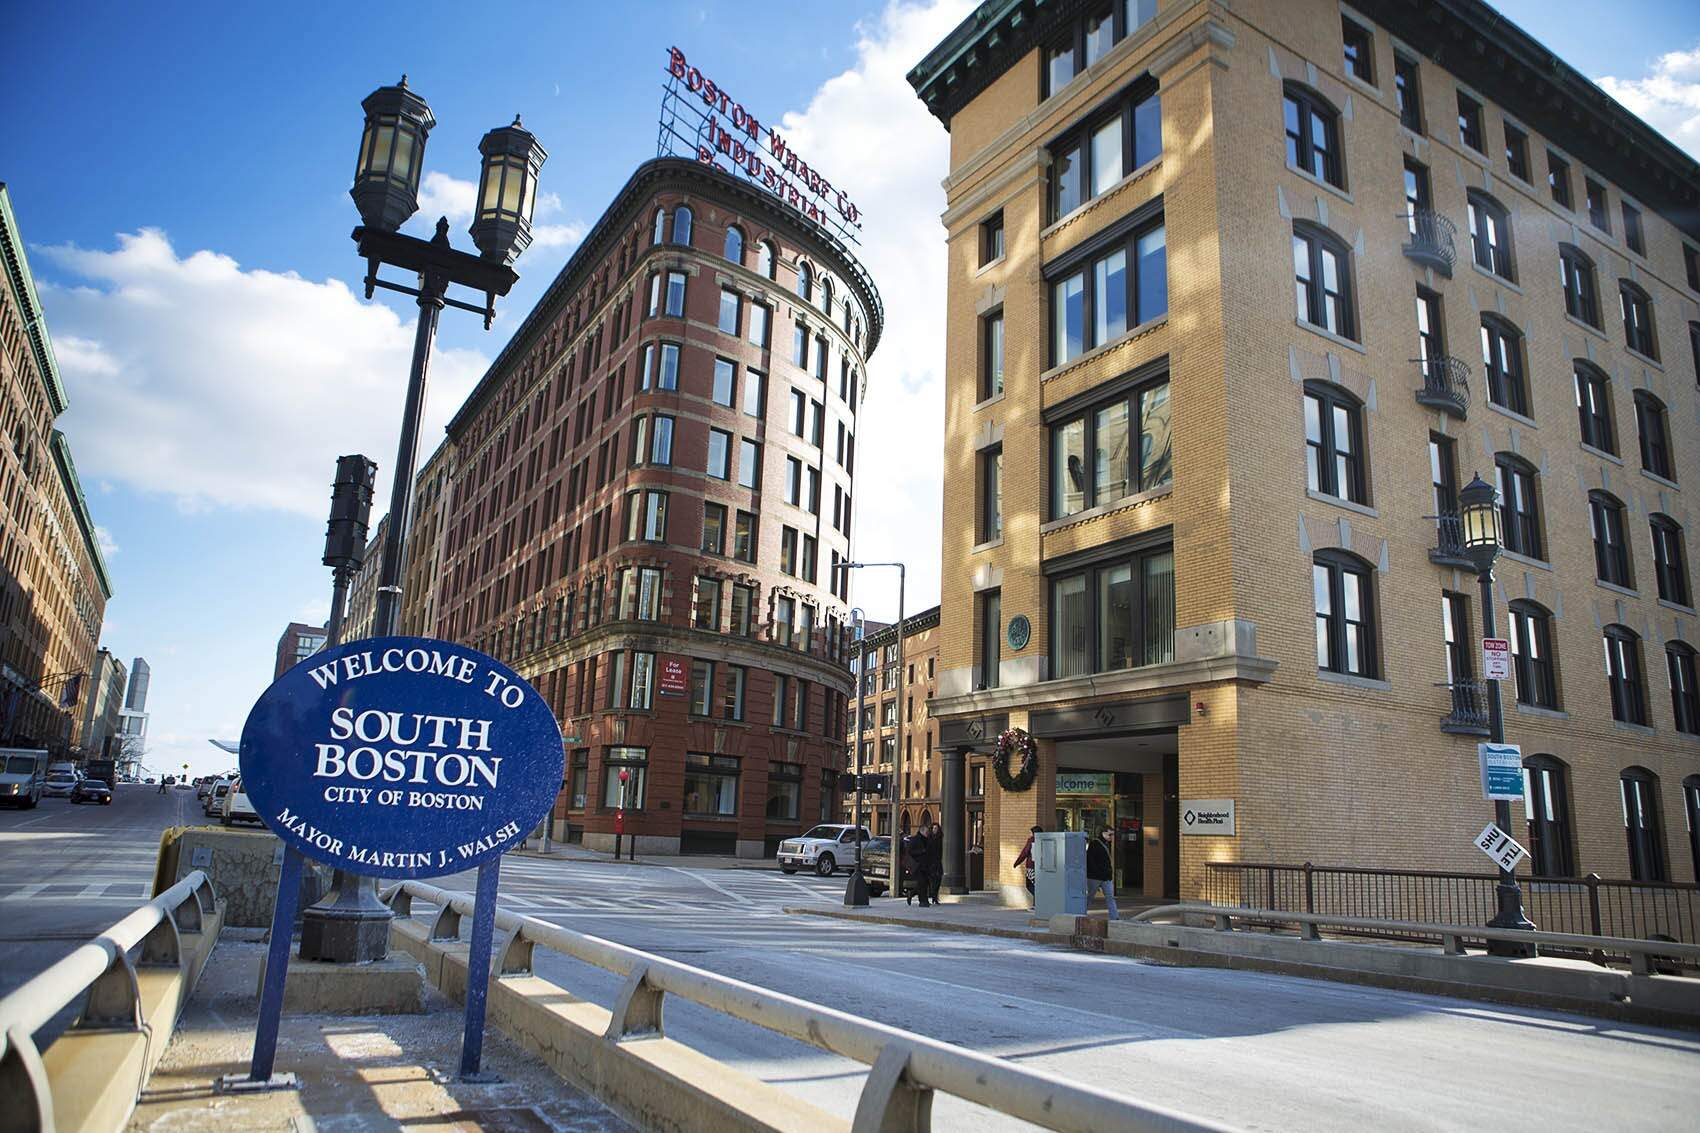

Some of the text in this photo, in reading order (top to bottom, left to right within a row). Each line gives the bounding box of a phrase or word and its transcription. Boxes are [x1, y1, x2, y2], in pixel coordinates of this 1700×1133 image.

[670, 46, 759, 141] BOSTON
[769, 127, 829, 198] WHARF
[1485, 641, 1494, 649] TOW
[308, 648, 525, 709] WELCOME TO
[665, 667, 682, 675] Lease
[330, 706, 493, 752] SOUTH
[313, 742, 503, 789] BOSTON
[324, 786, 485, 811] CITY OF BOSTON
[1197, 811, 1230, 819] Neighborhood
[276, 807, 521, 868] MAYOR MARTIN J. WALSH
